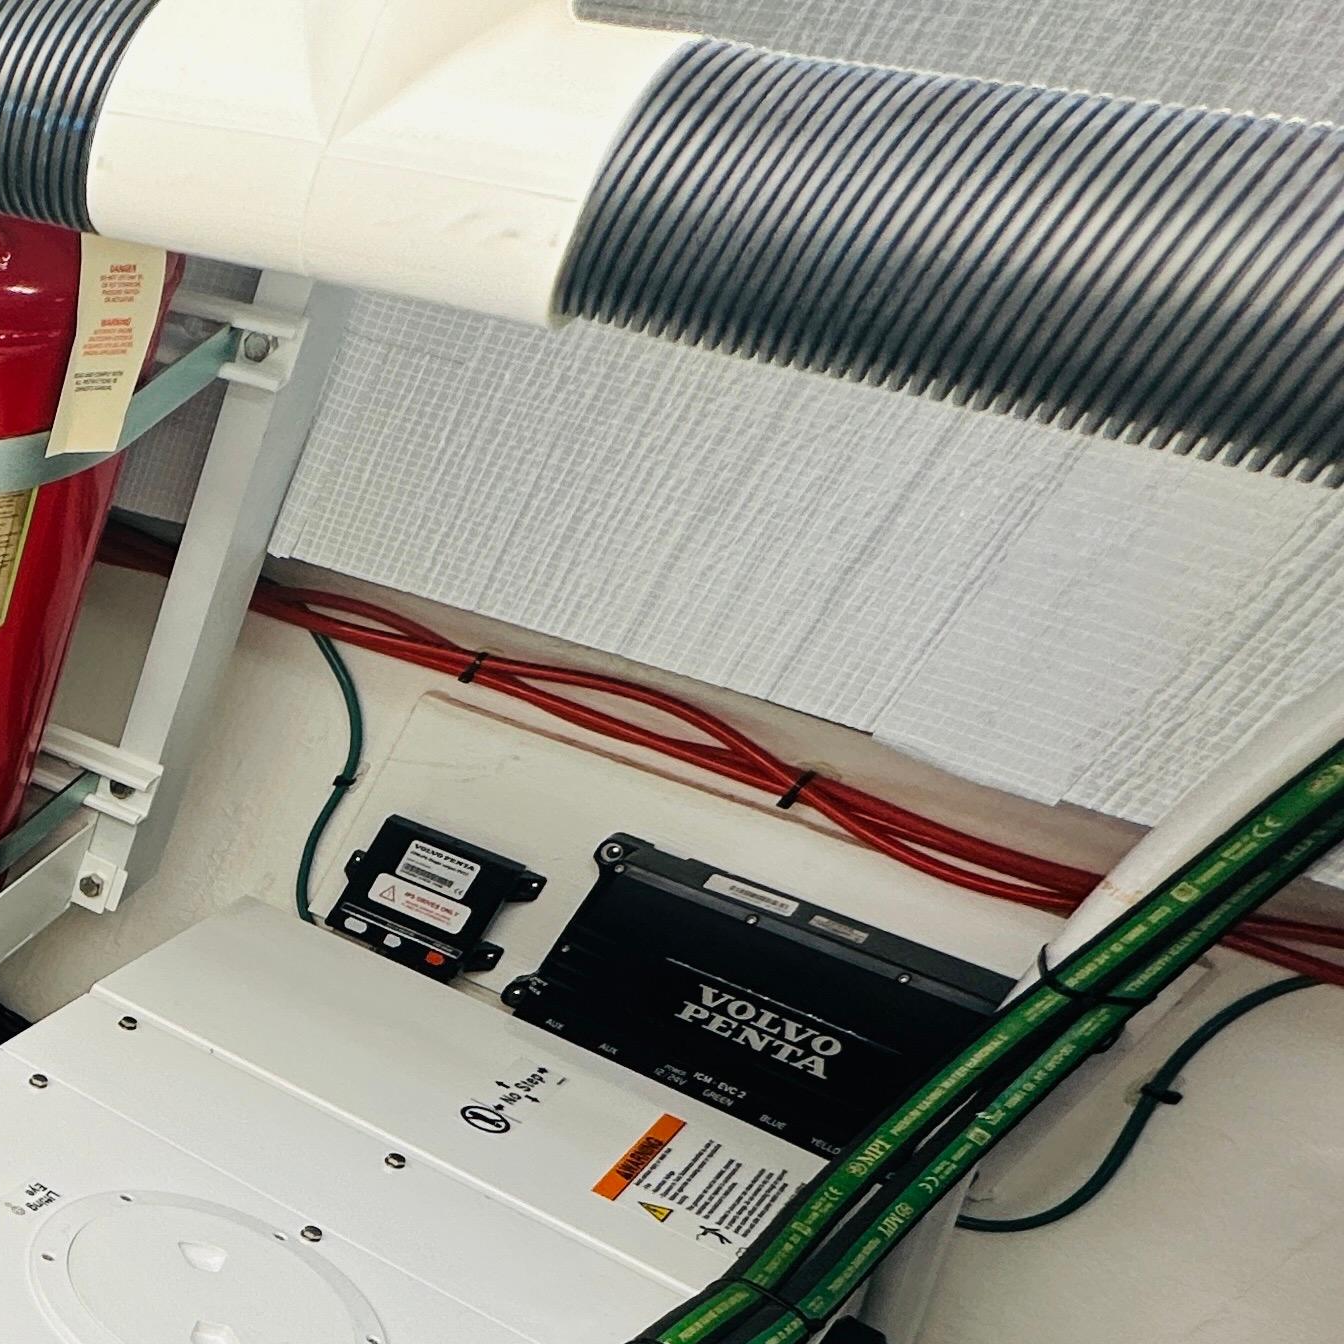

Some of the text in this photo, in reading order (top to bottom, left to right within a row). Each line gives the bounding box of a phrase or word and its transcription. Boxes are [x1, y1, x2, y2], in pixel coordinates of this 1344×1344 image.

[699, 984, 842, 1056] VOLVO
[674, 1001, 828, 1080] PENTA
[499, 1068, 544, 1107] No Step
[811, 1136, 842, 1156] YELLO
[23, 1178, 47, 1201] Eye
